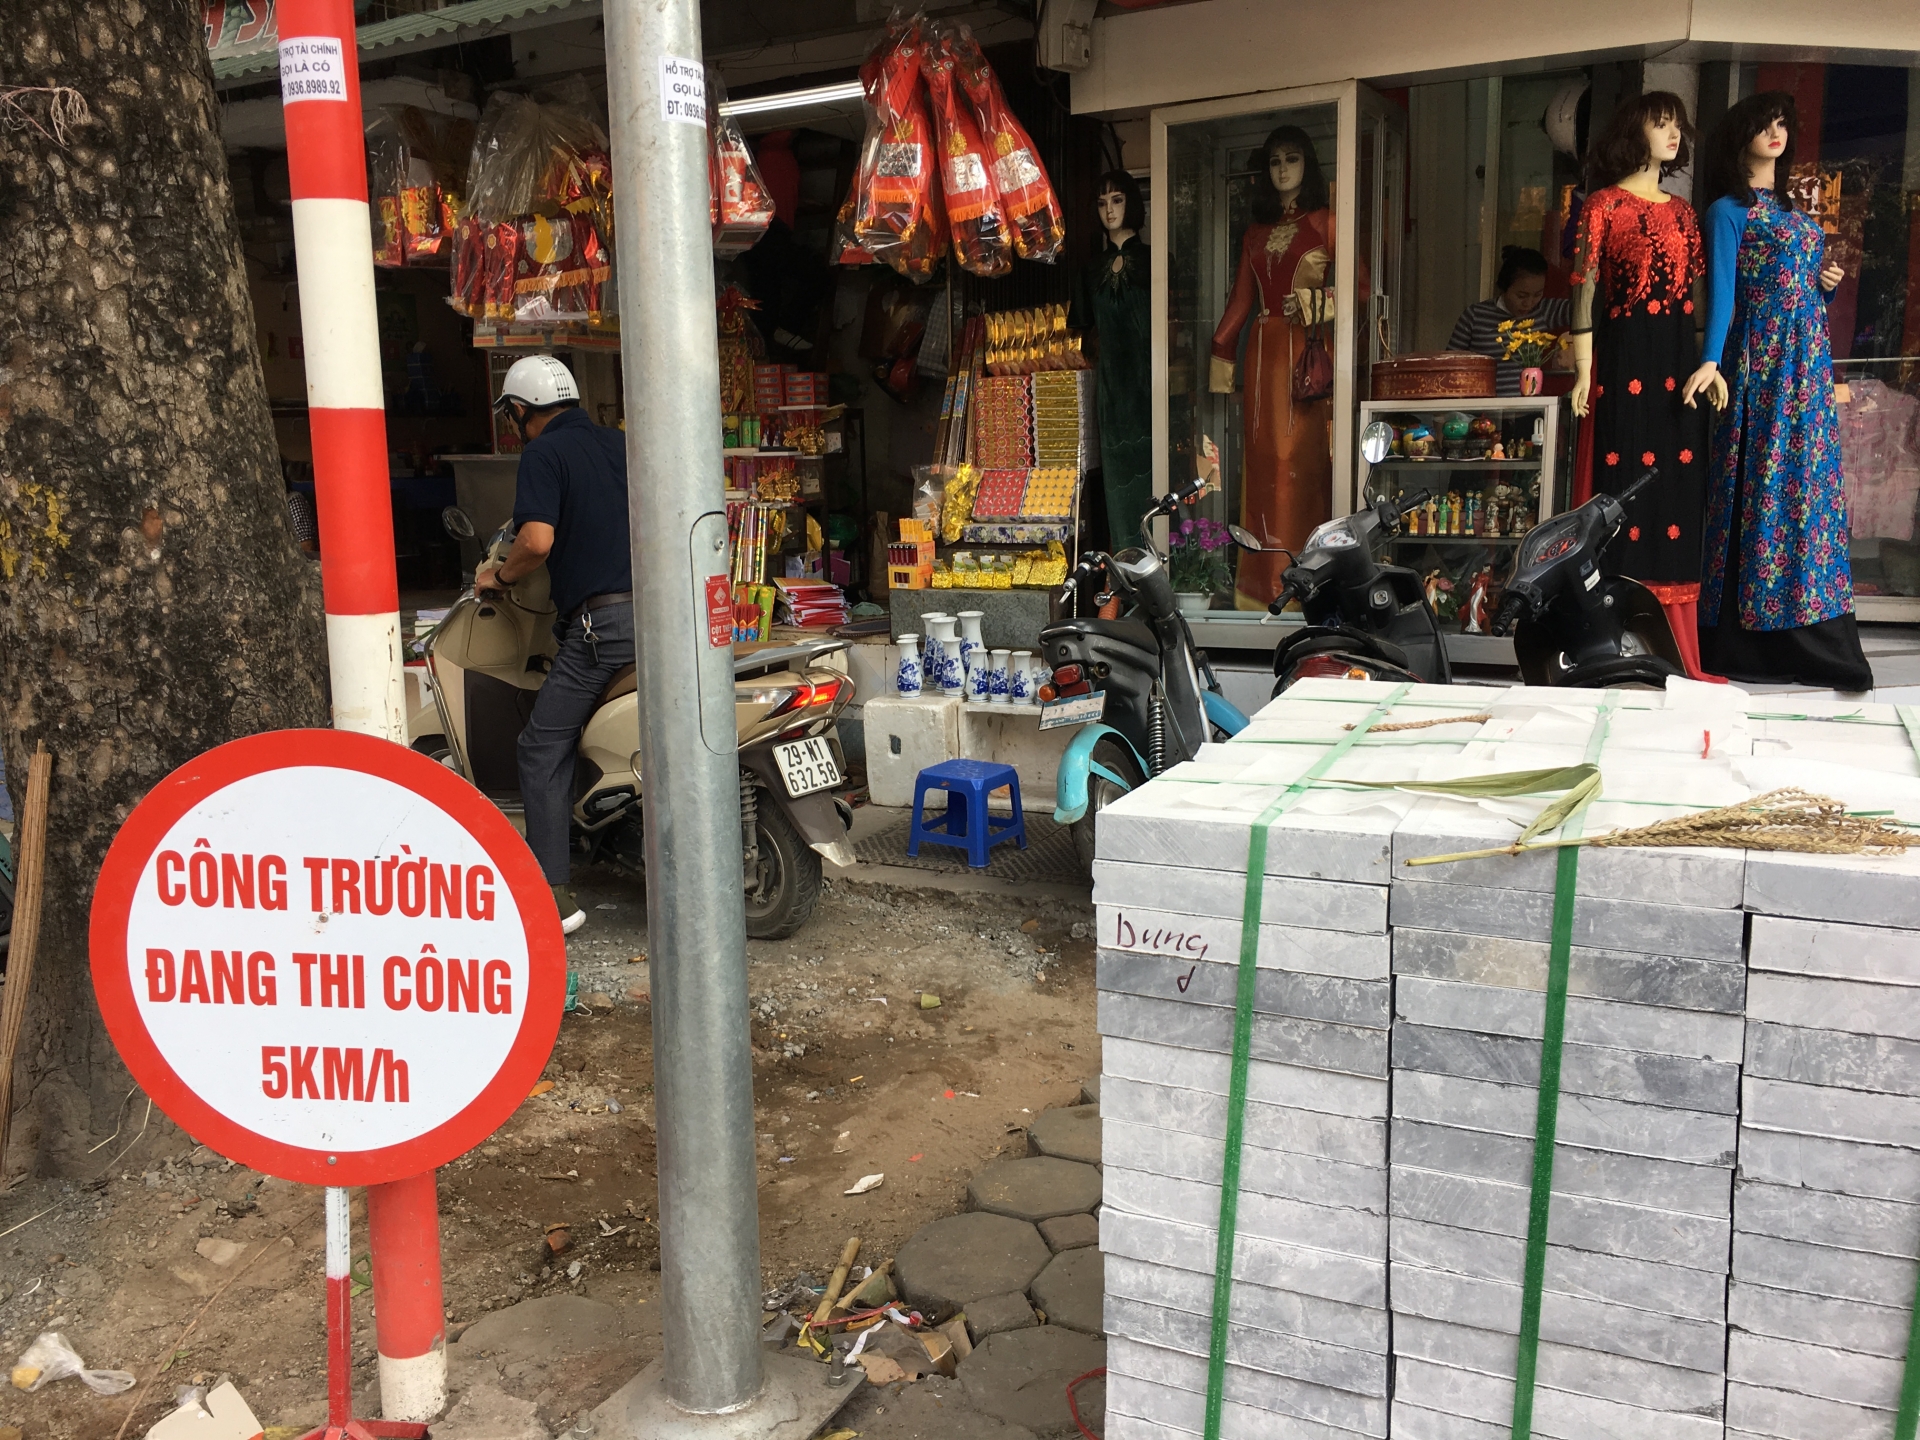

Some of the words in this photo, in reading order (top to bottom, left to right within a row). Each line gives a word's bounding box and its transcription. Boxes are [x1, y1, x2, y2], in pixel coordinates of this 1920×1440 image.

[295, 42, 309, 55] TÀI
[311, 43, 338, 55] CHÍNH
[295, 60, 309, 73] LÀ
[312, 60, 331, 72] CÓ
[665, 61, 678, 75] HỖ
[680, 66, 693, 80] TRỢ
[288, 80, 341, 96] 0936.8989.92
[673, 83, 691, 97] GỌI
[694, 84, 702, 98] LÀ
[667, 100, 682, 115] ĐT:
[782, 739, 824, 768] 29-N1
[788, 761, 838, 793] 632.58
[156, 837, 288, 911] CÔNG
[303, 844, 495, 921] TRƯỜNG
[145, 948, 277, 1006] ĐANG
[292, 952, 365, 1009] THI
[383, 943, 513, 1015] CÔNG
[261, 1046, 410, 1103] 5KM/h
